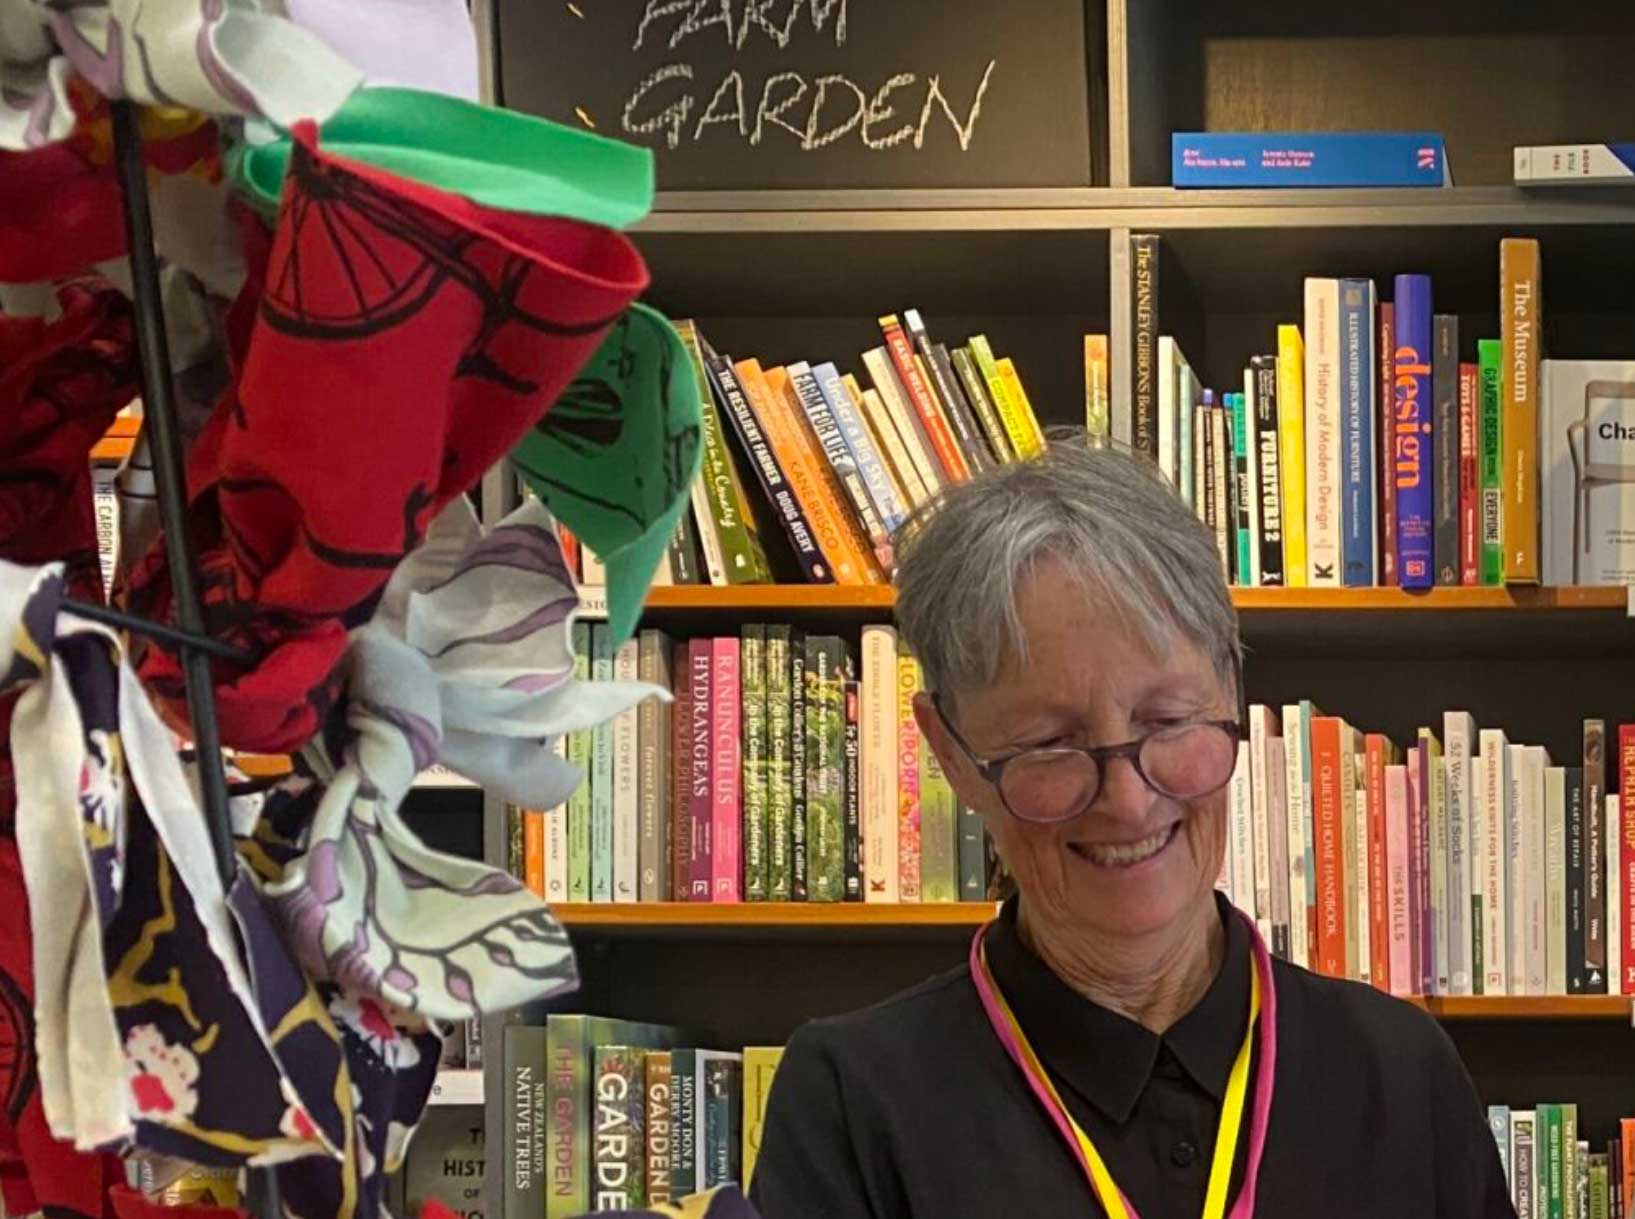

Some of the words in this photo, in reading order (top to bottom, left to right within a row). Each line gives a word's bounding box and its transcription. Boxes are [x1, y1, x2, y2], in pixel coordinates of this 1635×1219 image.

[621, 59, 996, 150] GARDEN
[1138, 271, 1152, 329] STANLEY
[1514, 280, 1530, 318] The
[1138, 332, 1152, 393] GIBBONS
[1316, 364, 1333, 410] History
[1514, 322, 1529, 402] Museum
[795, 371, 815, 407] FARM
[1484, 368, 1498, 416] GRAPHIC
[1395, 346, 1430, 488] design
[1484, 418, 1498, 456] DESIGN
[717, 370, 733, 389] THE
[725, 389, 763, 444] RESILIENT
[750, 440, 780, 486] FARMER
[775, 490, 794, 521] DOUG
[789, 517, 813, 553] AVERY
[1261, 430, 1279, 528] FURNITURE
[1319, 432, 1333, 481] Modern
[1350, 432, 1360, 482] FURNITURE
[1316, 487, 1333, 529] Design
[1486, 492, 1498, 541] EVERYONE
[1265, 531, 1277, 541] 2
[692, 655, 709, 797] HYDRANGEAS
[717, 655, 735, 805] RANUNCULUS
[1451, 762, 1462, 804] Weeks
[1487, 742, 1496, 799] WILDERNESS
[749, 806, 761, 865] Gardeners
[774, 806, 786, 865] Gardeners
[1452, 826, 1462, 864] Socks
[1393, 888, 1404, 941] SKILLS
[1489, 881, 1497, 910] HOME
[554, 1040, 572, 1089] THE
[515, 1067, 531, 1132] NATIVE
[682, 1075, 692, 1124] MONTY
[554, 1097, 573, 1197] GARDEN
[650, 1083, 668, 1186] GARDEN
[672, 1122, 680, 1169] MOORE
[682, 1129, 692, 1155] DON
[515, 1136, 530, 1191] TREES
